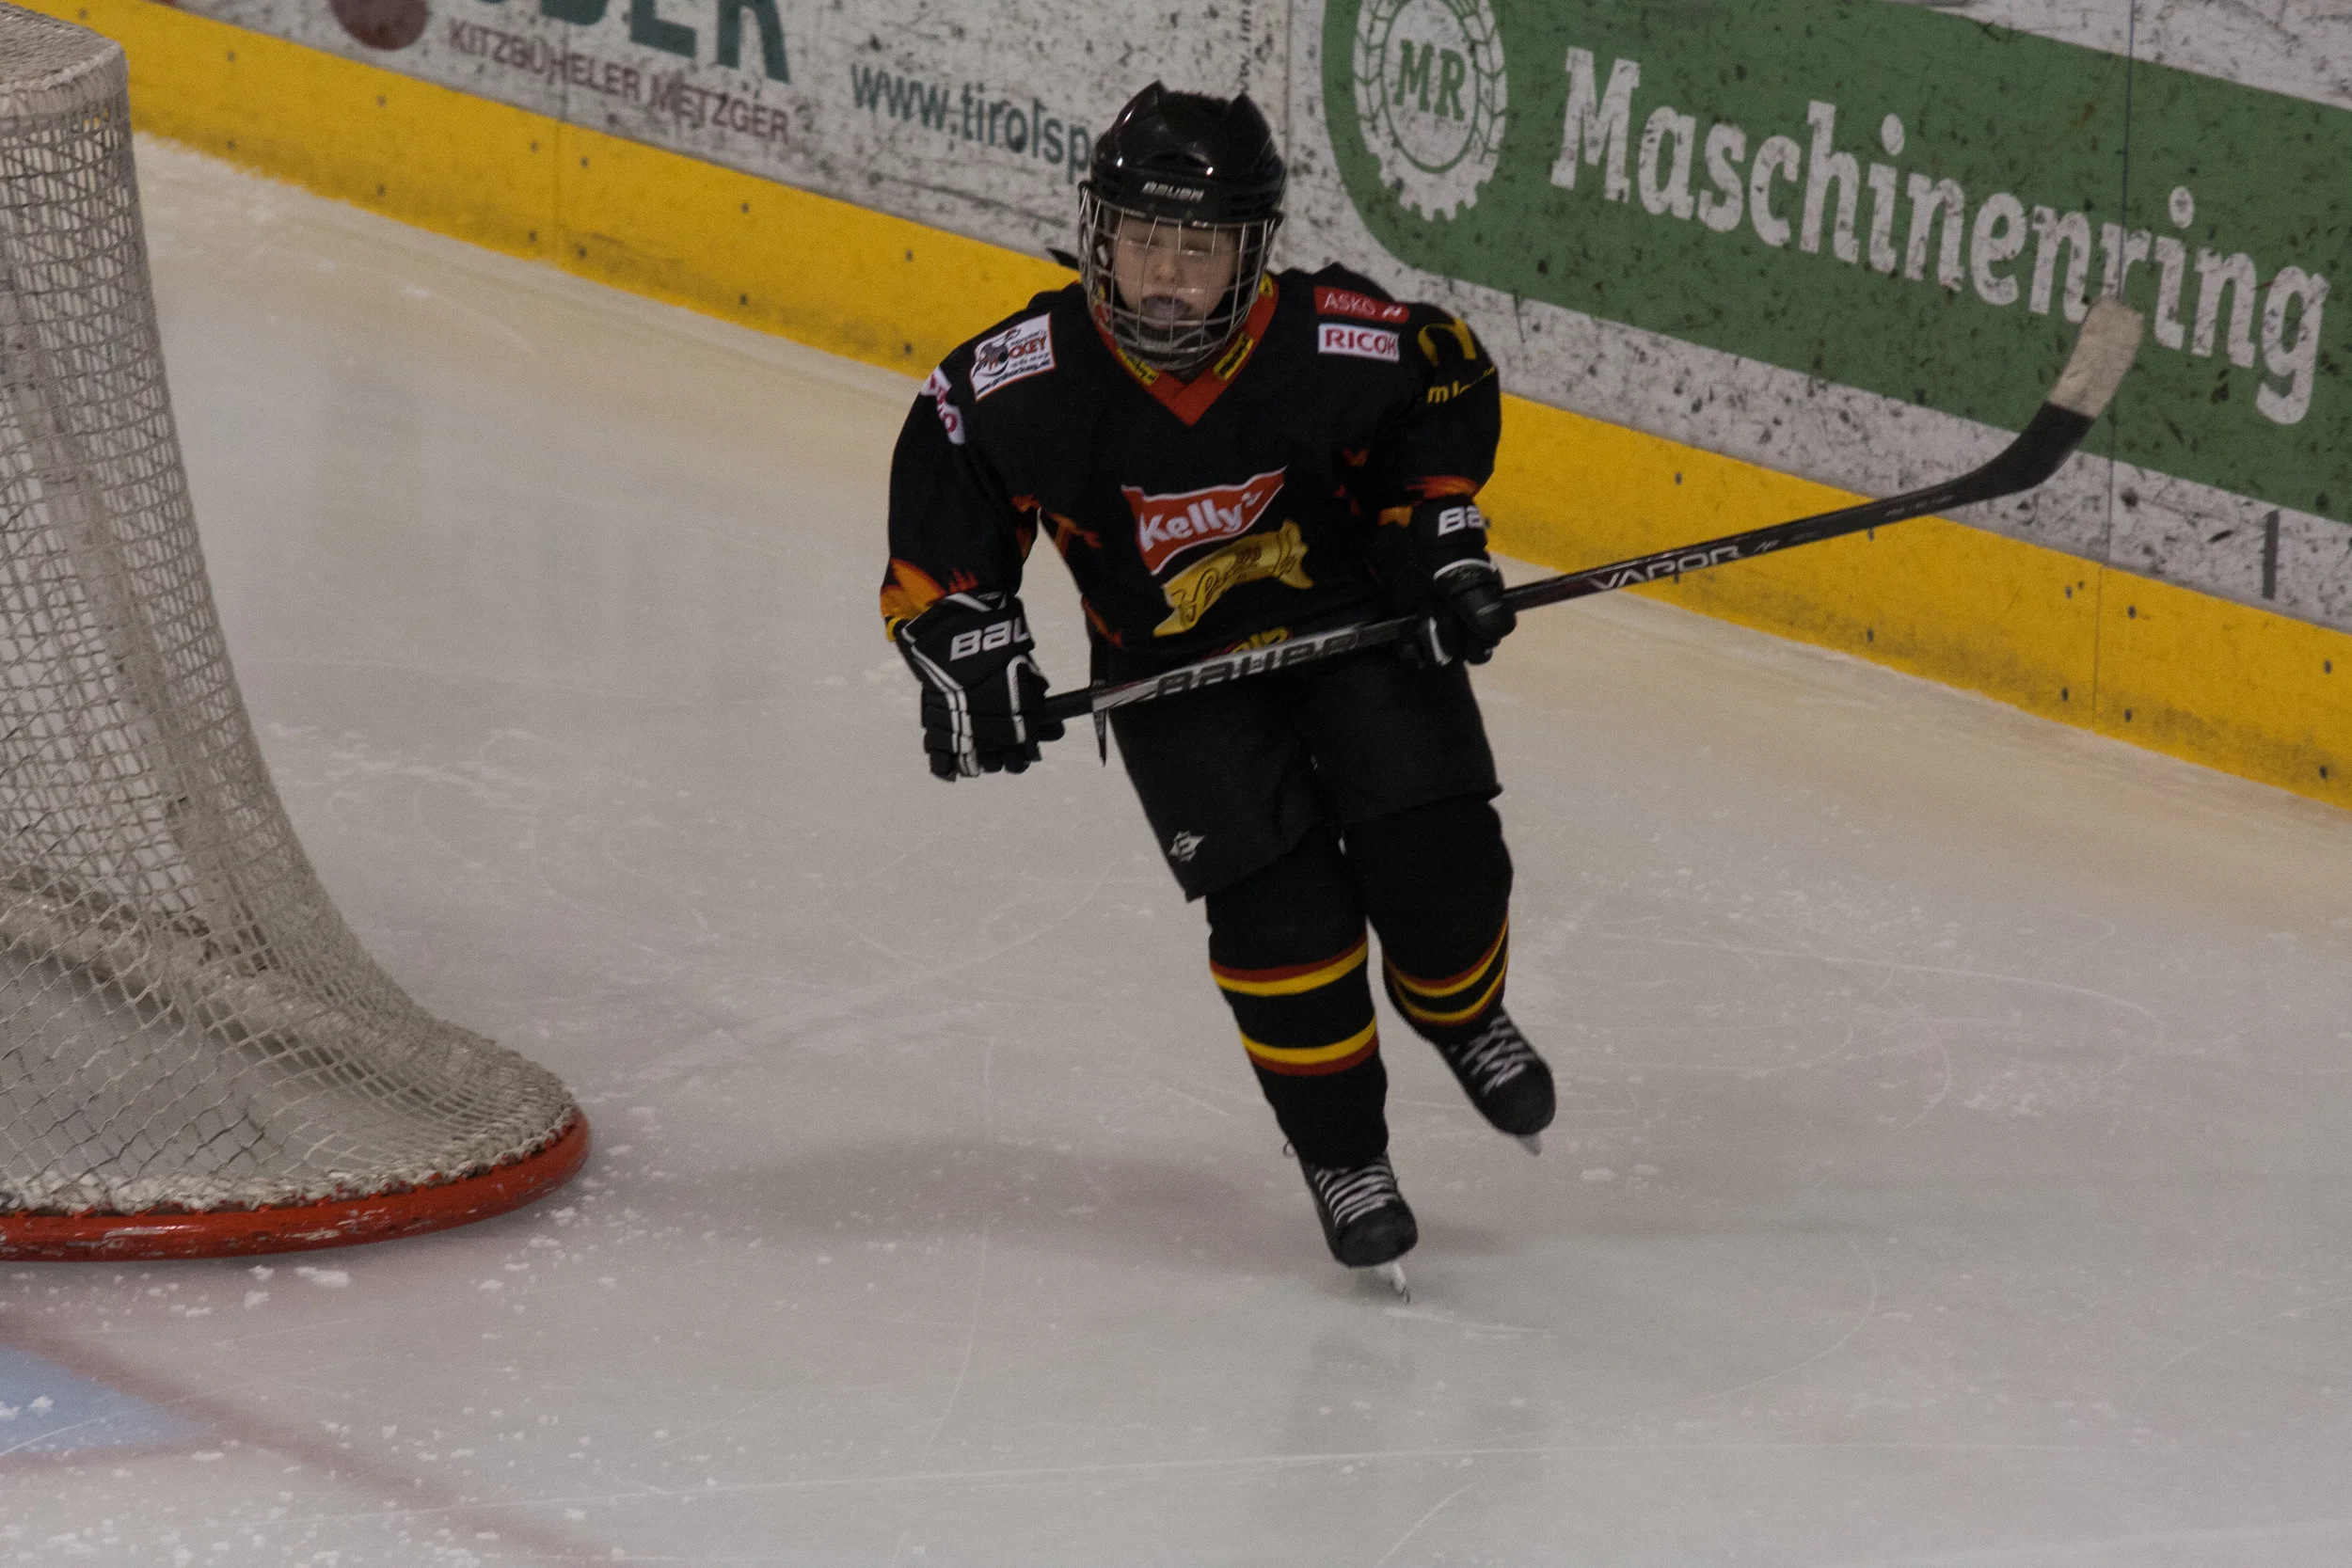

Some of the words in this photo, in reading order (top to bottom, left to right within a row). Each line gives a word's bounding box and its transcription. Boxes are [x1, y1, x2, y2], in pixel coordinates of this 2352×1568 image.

[1395, 39, 1466, 121] MR
[1551, 46, 2330, 424] Maschinenring
[1588, 545, 1744, 591] VAPOR
